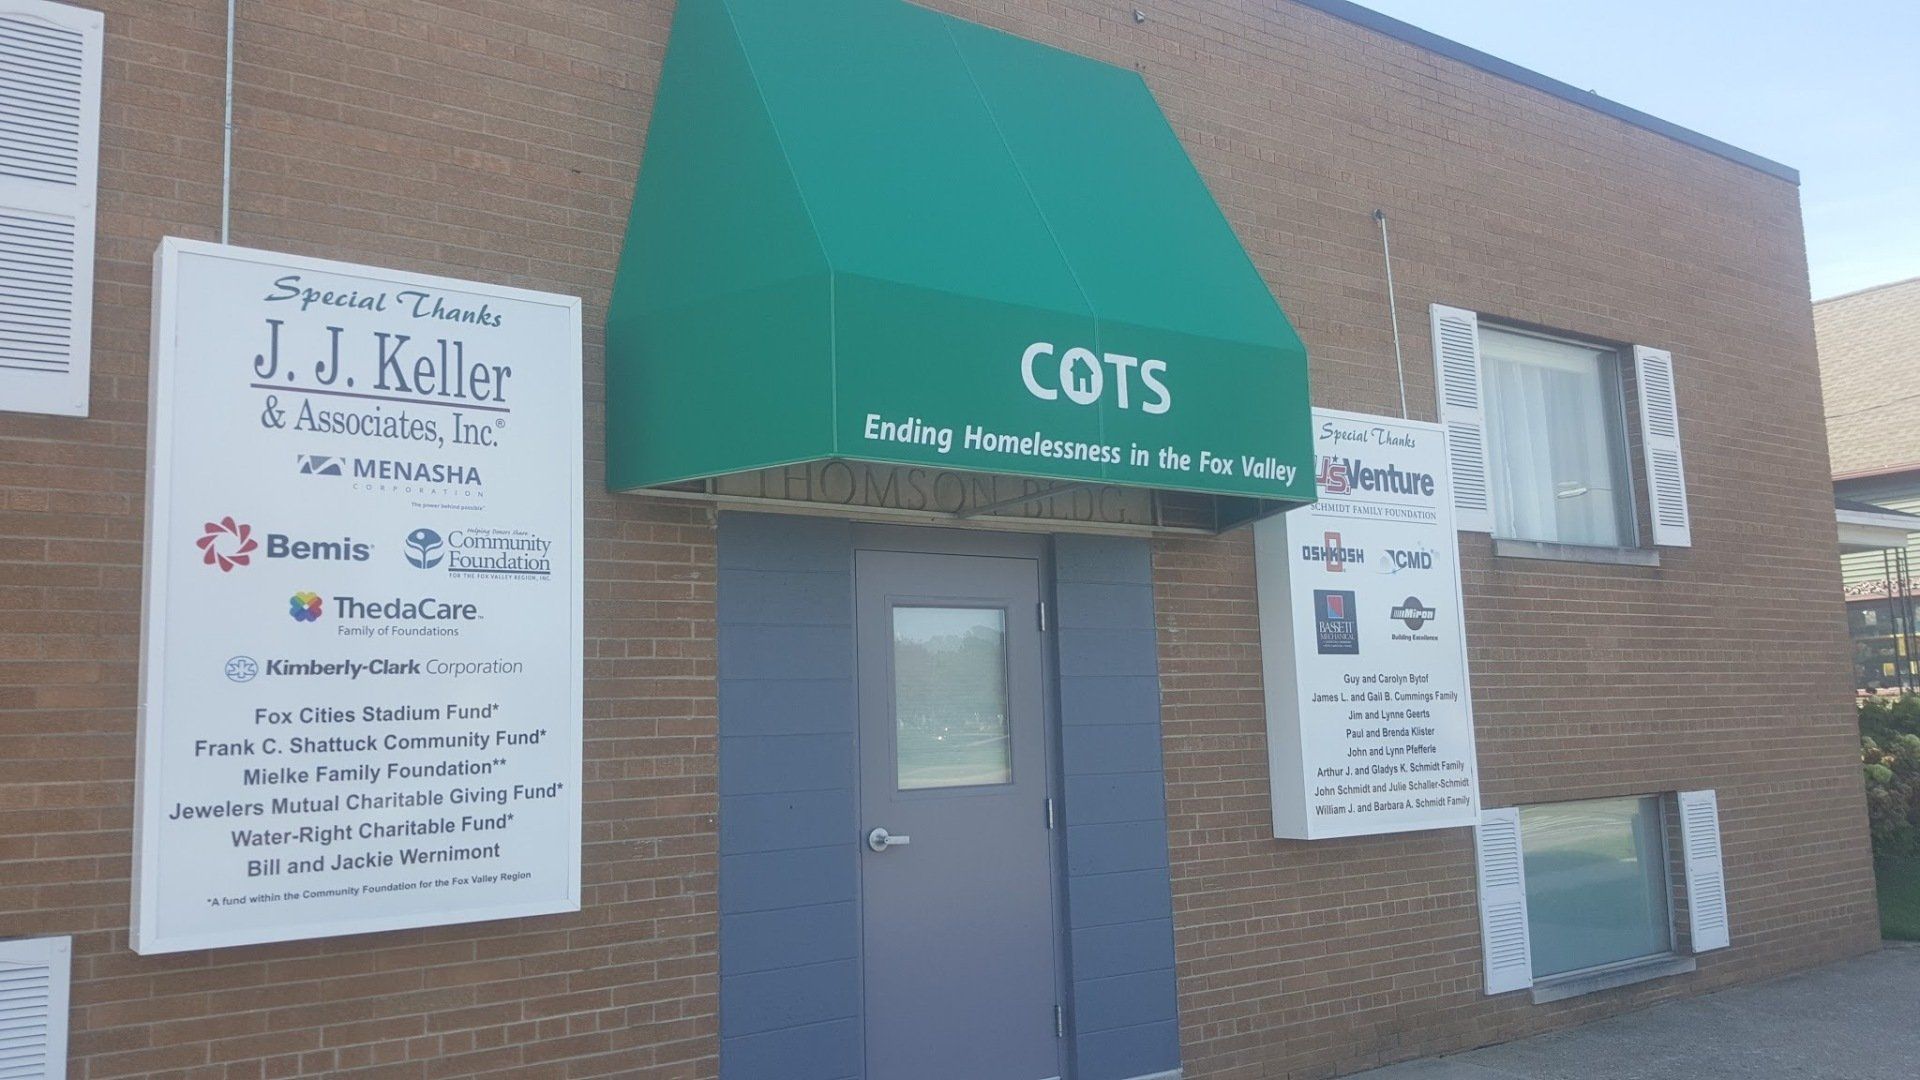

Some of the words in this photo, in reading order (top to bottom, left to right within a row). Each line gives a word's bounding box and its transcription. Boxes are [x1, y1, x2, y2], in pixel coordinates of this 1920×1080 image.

[265, 275, 386, 313] Special
[397, 290, 501, 327] Thanks
[254, 318, 295, 381] J.
[315, 325, 354, 387] J.
[373, 332, 511, 402] Keller
[1020, 341, 1171, 415] COTS
[261, 395, 286, 429] &
[295, 398, 444, 449] Associates,
[1320, 422, 1367, 444] Special
[1371, 428, 1415, 448] Thanks
[864, 413, 952, 453] Ending
[964, 425, 1121, 465] Homelessness
[1130, 443, 1149, 466] in
[1158, 446, 1190, 472] the
[1200, 451, 1233, 476] Fox
[1242, 455, 1296, 488] Valley
[354, 459, 482, 485] MENASHA
[353, 483, 484, 497] CORPORATION
[1311, 503, 1350, 512] SCHMIDT
[1353, 505, 1383, 516] FAMILY
[1385, 508, 1436, 519] FOUNDATION
[267, 532, 369, 561] Bemis
[448, 531, 552, 557] Community
[450, 551, 550, 570] Foundation
[1396, 551, 1432, 570] CMD
[338, 626, 373, 638] Family
[376, 625, 389, 637] of
[391, 625, 459, 637] Foundations
[265, 658, 420, 679] Kimberly-Clark
[425, 658, 522, 676] Corporation
[1344, 674, 1359, 684] Guy
[1362, 674, 1376, 683] and
[1379, 674, 1407, 684] Carolyn
[1410, 673, 1428, 684] Bytof
[1312, 693, 1338, 702] James
[1341, 693, 1348, 701] L.
[1351, 692, 1365, 701] and
[1368, 692, 1382, 701] Gail
[1385, 692, 1392, 701] B.
[1395, 692, 1433, 702] Cummings
[1435, 691, 1458, 702] Family
[255, 707, 292, 724] Fox
[300, 706, 355, 723] Cities
[362, 704, 440, 722] Stadium
[1349, 711, 1362, 719] Jim
[1365, 710, 1379, 719] and
[1382, 710, 1403, 721] Lynne
[1406, 709, 1430, 718] Geerts
[1346, 729, 1363, 738] Paul
[1366, 728, 1380, 737] and
[1383, 728, 1409, 737] Brenda
[194, 739, 254, 756] Frank
[262, 738, 282, 755] C.
[290, 735, 376, 754] Shattuck
[384, 732, 490, 753] Community
[1348, 747, 1367, 757] John
[1370, 747, 1383, 756] and
[1386, 746, 1404, 757] Lynn
[243, 767, 308, 786] Mielke
[316, 765, 380, 787] Family
[1317, 768, 1343, 777] Arthur
[1346, 767, 1353, 776] J.
[1355, 766, 1369, 775] and
[1372, 765, 1398, 775] Gladys
[1400, 764, 1408, 772] K.
[1410, 762, 1439, 772] Schmidt
[1442, 761, 1464, 771] Family
[1315, 786, 1335, 796] John
[1337, 784, 1370, 795] Schmidt
[1373, 783, 1386, 792] and
[1389, 782, 1406, 792] Julie
[169, 801, 264, 820] Jewelers
[272, 796, 339, 815] Mutual
[346, 791, 443, 811] Charitable
[450, 787, 508, 808] Giving
[1316, 805, 1346, 815] William
[1348, 804, 1355, 813] J.
[1358, 803, 1371, 812] and
[1374, 801, 1404, 811] Barbara
[1406, 800, 1413, 809] A.
[1416, 798, 1445, 808] Schmidt
[1447, 796, 1470, 806] Family
[232, 827, 352, 850] Water-Right
[358, 819, 455, 839] Charitable
[247, 859, 280, 876] Bill
[287, 858, 324, 874] and
[331, 851, 393, 872] Jackie
[400, 844, 500, 865] Wernimont
[222, 895, 246, 906] fund
[249, 893, 280, 904] within
[283, 891, 299, 900] the
[303, 887, 360, 900] Community
[363, 881, 416, 894] Foundation
[419, 880, 432, 888] for
[435, 878, 449, 887] the
[452, 876, 469, 886] Fox
[472, 874, 498, 885] Valley
[500, 871, 531, 884] Region
